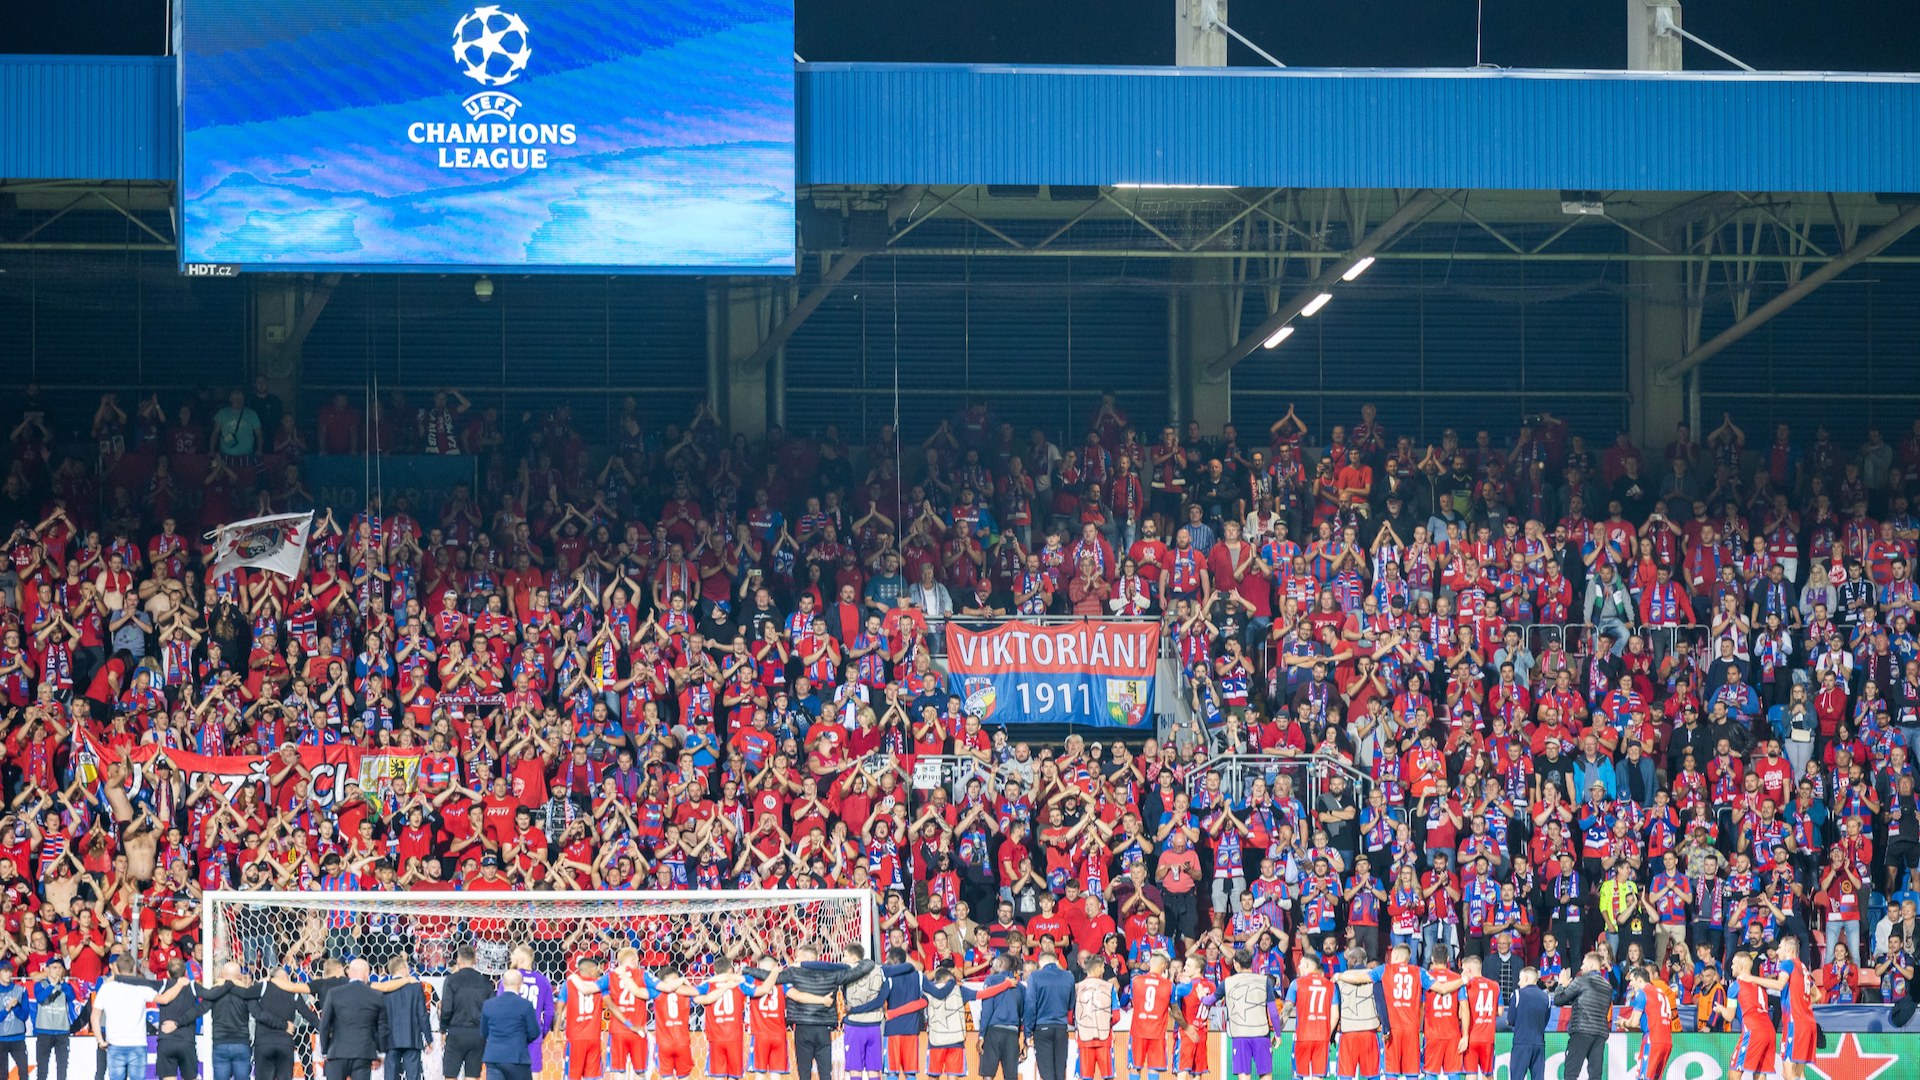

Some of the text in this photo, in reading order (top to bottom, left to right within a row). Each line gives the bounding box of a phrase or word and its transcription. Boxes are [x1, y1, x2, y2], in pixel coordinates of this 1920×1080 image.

[465, 96, 517, 117] UEFA
[407, 122, 577, 144] CHAMPIONS
[438, 147, 548, 169] LEAGUE
[957, 630, 1148, 671] VIKTORIÁNI
[1016, 682, 1091, 716] 1911
[758, 986, 779, 1011] 23
[1143, 985, 1156, 1013] 9
[1308, 986, 1327, 1013] 77
[1393, 973, 1413, 1001] 33
[667, 992, 679, 1019] 6
[713, 988, 735, 1016] 20
[1474, 989, 1494, 1017] 44
